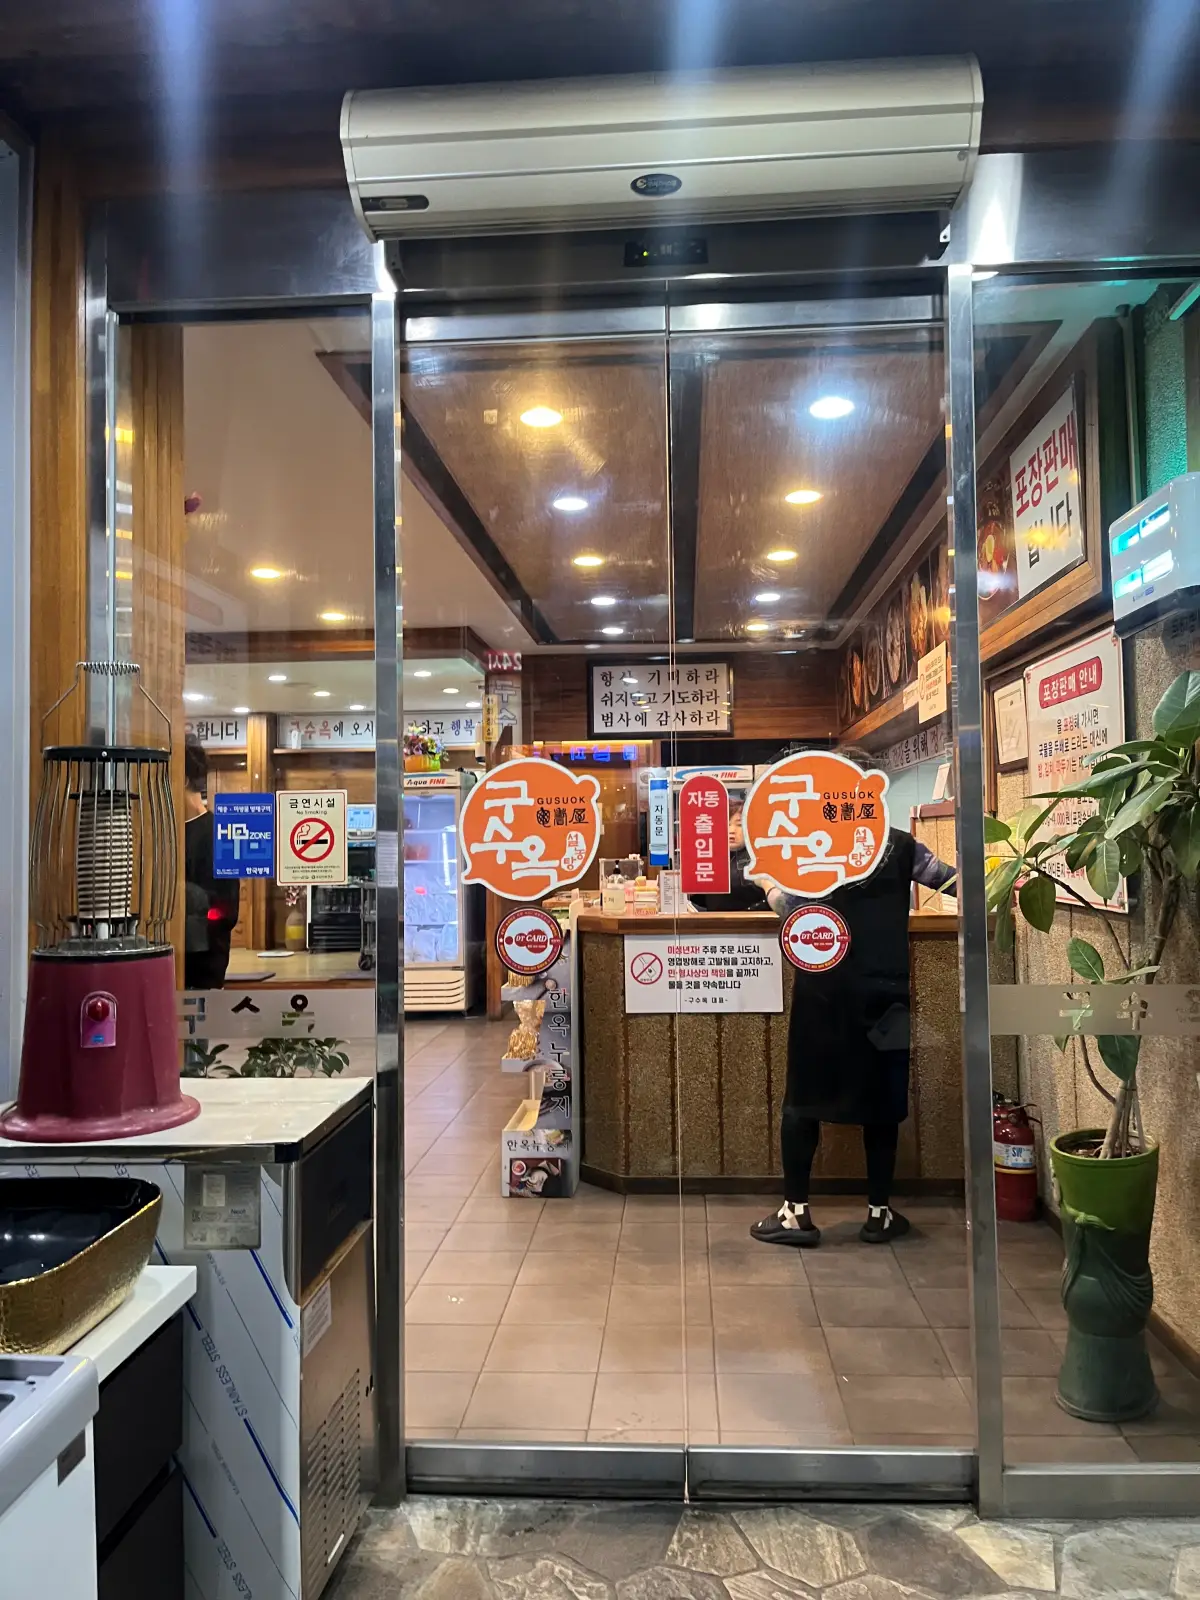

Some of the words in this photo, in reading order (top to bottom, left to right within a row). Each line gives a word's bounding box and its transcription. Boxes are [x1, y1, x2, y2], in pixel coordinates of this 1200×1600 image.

[1014, 409, 1077, 518] 포장판매
[1043, 672, 1076, 701] 포장판매
[1079, 663, 1097, 689] 안내
[661, 689, 720, 706] 기도하라
[601, 711, 648, 727] 범사에
[655, 710, 721, 726] 감사하라
[1081, 707, 1099, 728] 가시면
[184, 720, 239, 741] 합니다
[289, 797, 335, 809] 금연시설
[537, 796, 586, 805] GUSUOK
[687, 790, 720, 808] 자동
[823, 791, 875, 800] GUSUOK
[654, 805, 663, 837] 자동문
[249, 832, 272, 840] ZONE
[563, 833, 584, 871] 설농탕
[694, 814, 714, 882] 출입문
[526, 934, 547, 942] CARD
[812, 932, 834, 940] CARD
[667, 945, 700, 955] 미성년자!
[702, 945, 718, 954] 주류
[719, 945, 735, 954] 주문
[737, 945, 760, 954] 시도시
[711, 968, 734, 978] 책임을
[736, 968, 759, 978] 끝까지
[685, 980, 701, 990] 것을
[703, 980, 741, 989] 약속합니다
[201, 1330, 221, 1363] STEEL
